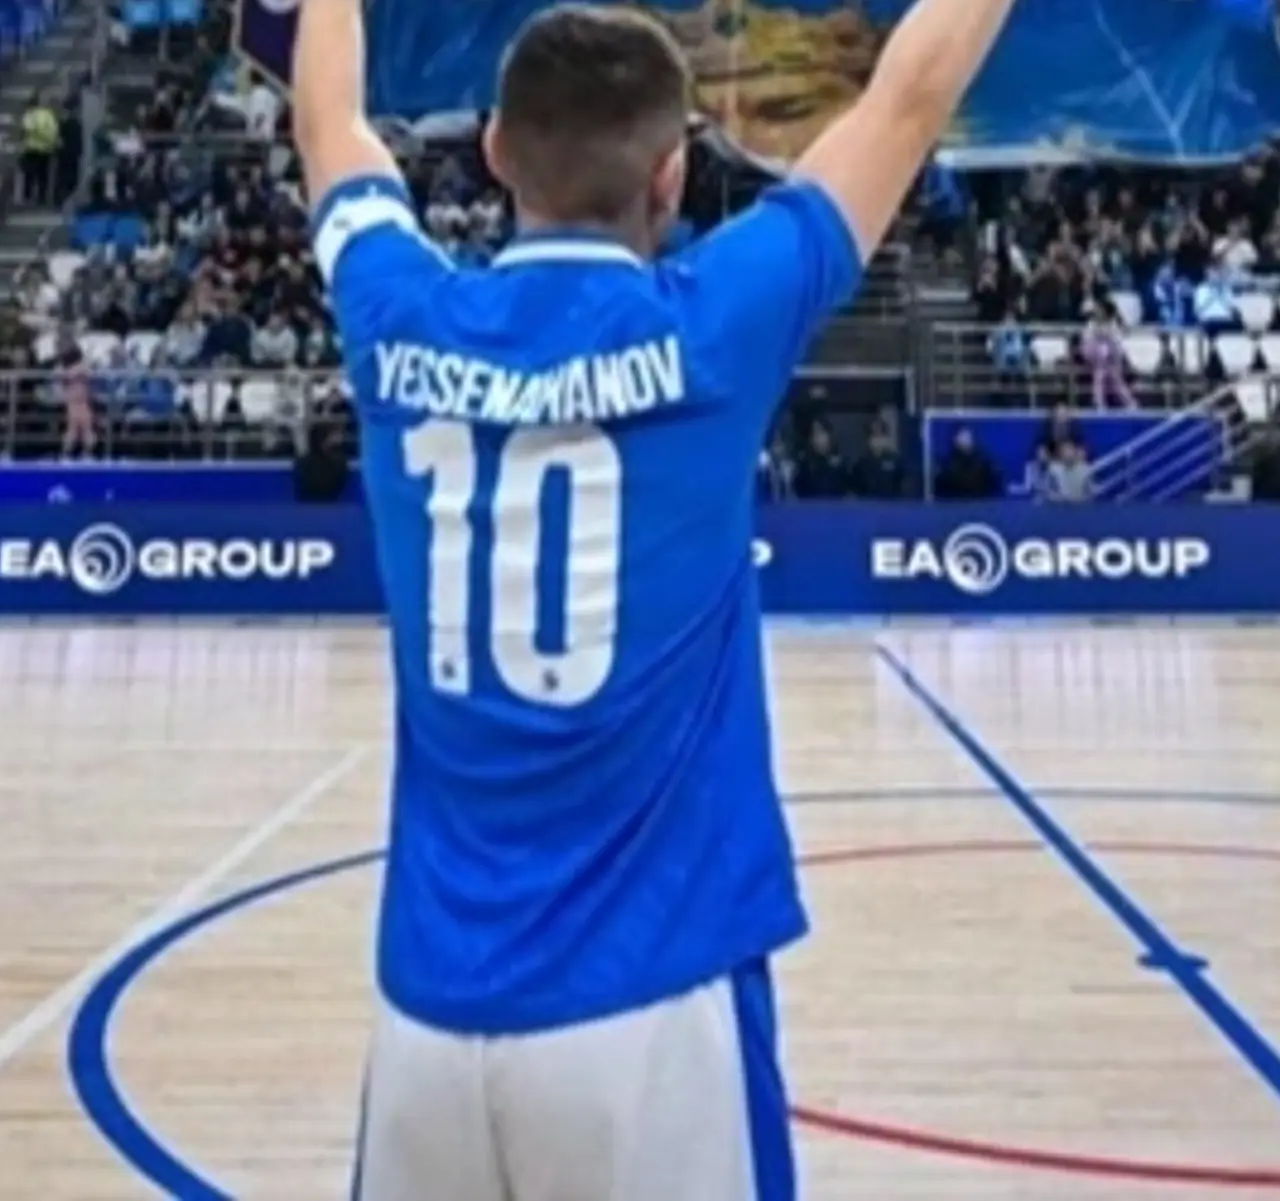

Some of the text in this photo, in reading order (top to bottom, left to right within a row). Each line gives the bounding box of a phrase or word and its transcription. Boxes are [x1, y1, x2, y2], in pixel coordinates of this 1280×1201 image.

[137, 539, 335, 577] GROUP
[402, 418, 622, 708] 10
[871, 539, 1210, 577] EA GROUP
